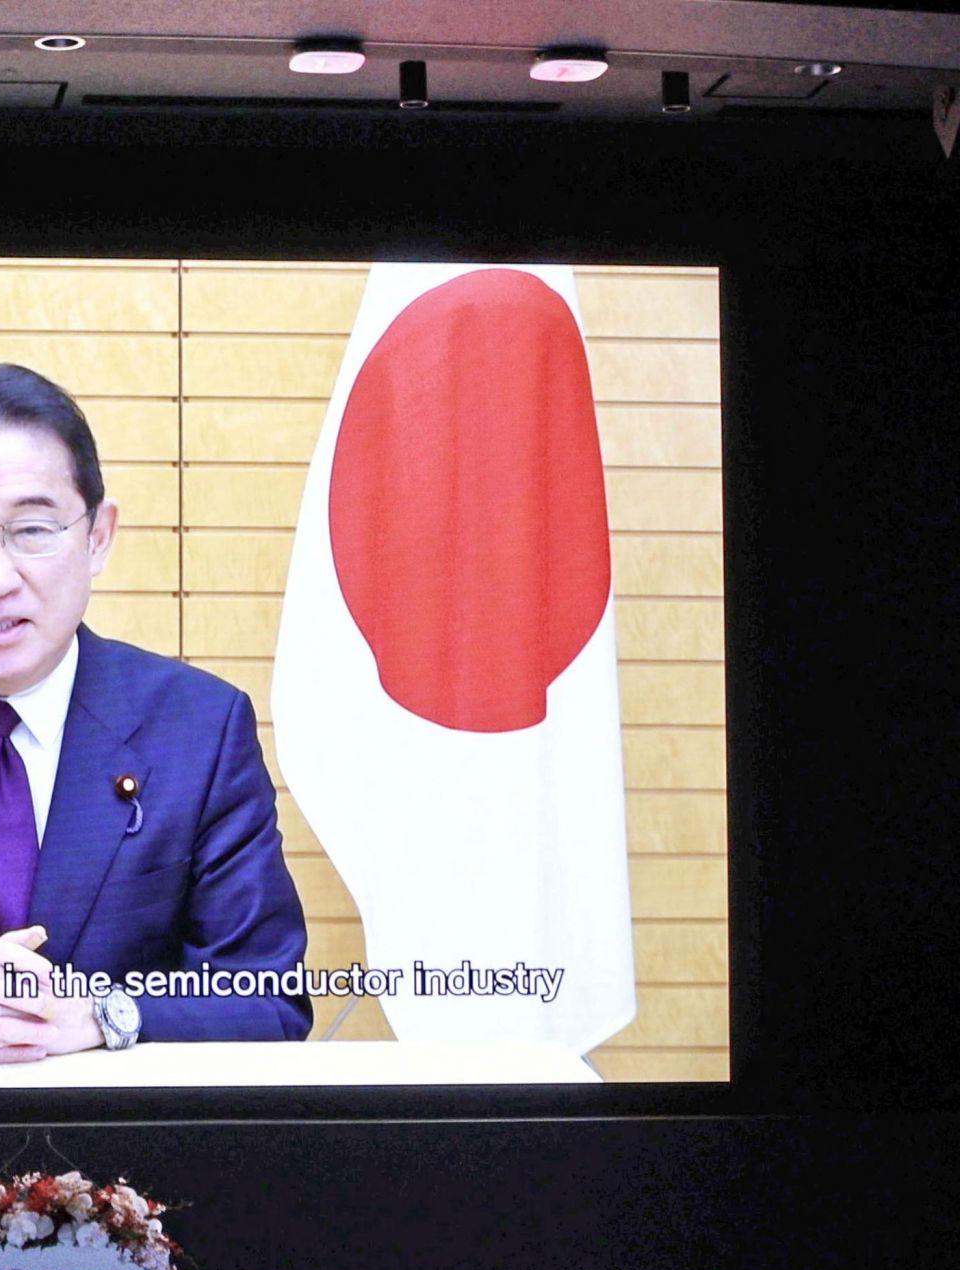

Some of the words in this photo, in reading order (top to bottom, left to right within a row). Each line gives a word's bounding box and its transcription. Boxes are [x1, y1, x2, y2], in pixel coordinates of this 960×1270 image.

[3, 963, 39, 999] in
[49, 962, 113, 998] the
[123, 961, 404, 998] semiconductor
[413, 960, 565, 1003] industry
